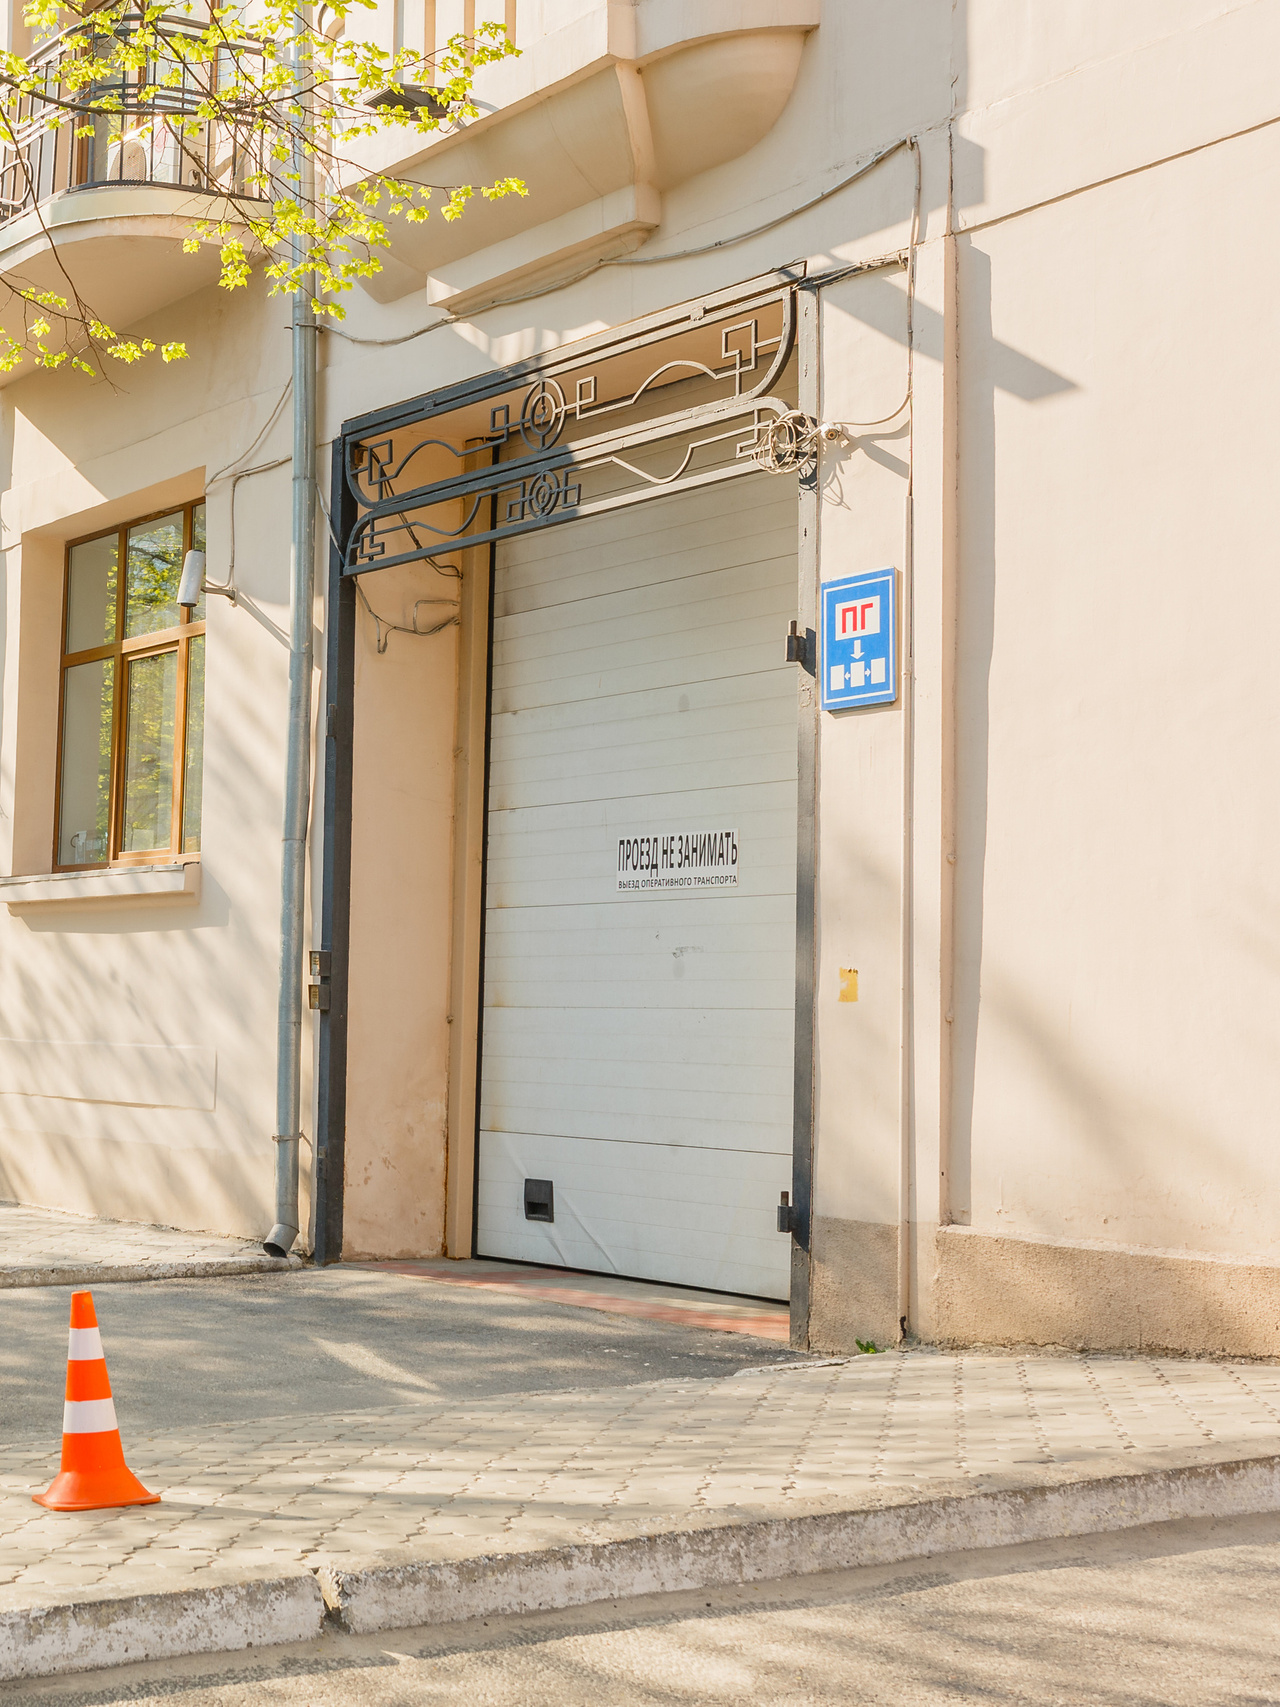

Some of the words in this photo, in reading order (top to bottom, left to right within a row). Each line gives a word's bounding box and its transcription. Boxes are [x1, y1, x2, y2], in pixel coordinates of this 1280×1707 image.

[841, 602, 874, 634] ПГ
[618, 837, 659, 877] ПРОЕЗД
[661, 836, 675, 869] НЕ
[677, 831, 738, 868] ЗАНИМАТЬ
[618, 879, 640, 889] ВЫЕЗД
[641, 877, 692, 888] ОПЕРАТИВНОГО
[693, 875, 737, 886] ТРАНСПОРТА
